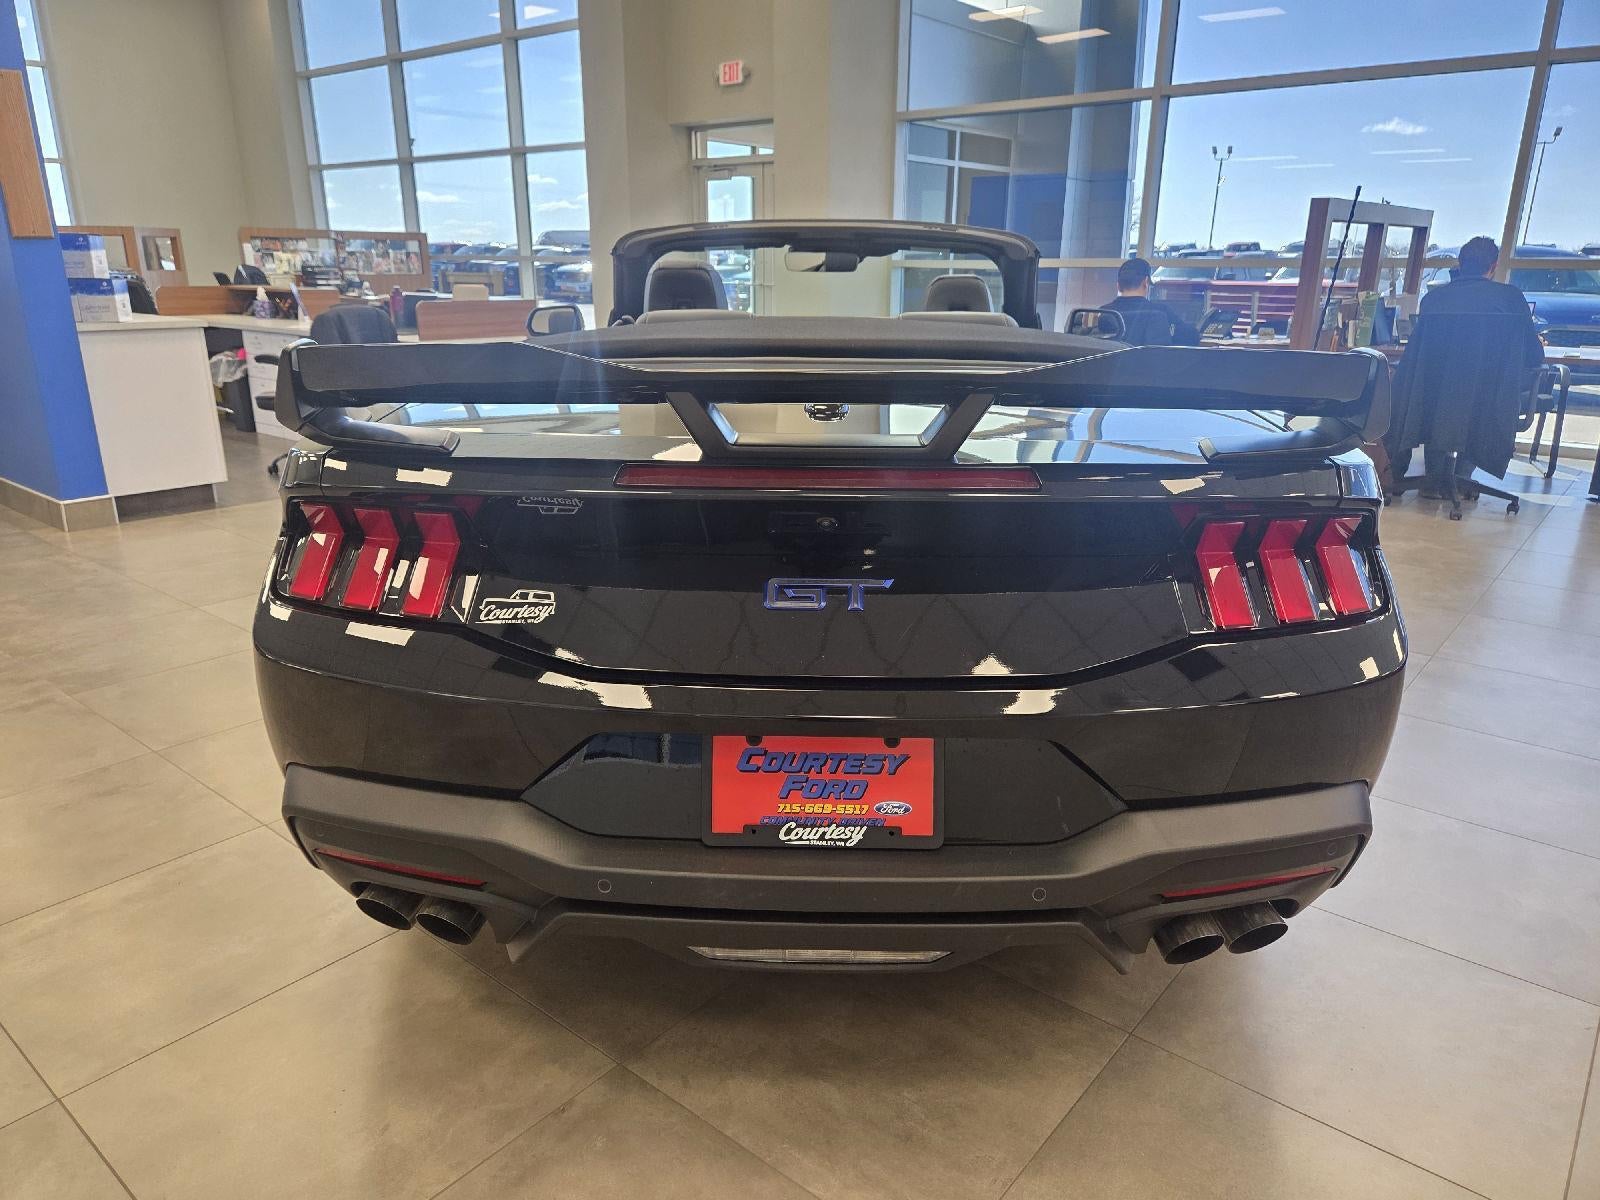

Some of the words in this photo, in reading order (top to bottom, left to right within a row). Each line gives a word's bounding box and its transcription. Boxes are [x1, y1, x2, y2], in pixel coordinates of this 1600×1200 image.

[723, 63, 740, 82] EXIT
[763, 578, 895, 612] GT
[480, 604, 550, 624] Courtesy
[737, 747, 911, 775] COURTESY
[778, 775, 868, 800] FORD
[879, 803, 906, 815] Ford
[778, 821, 867, 847] Courtesy
